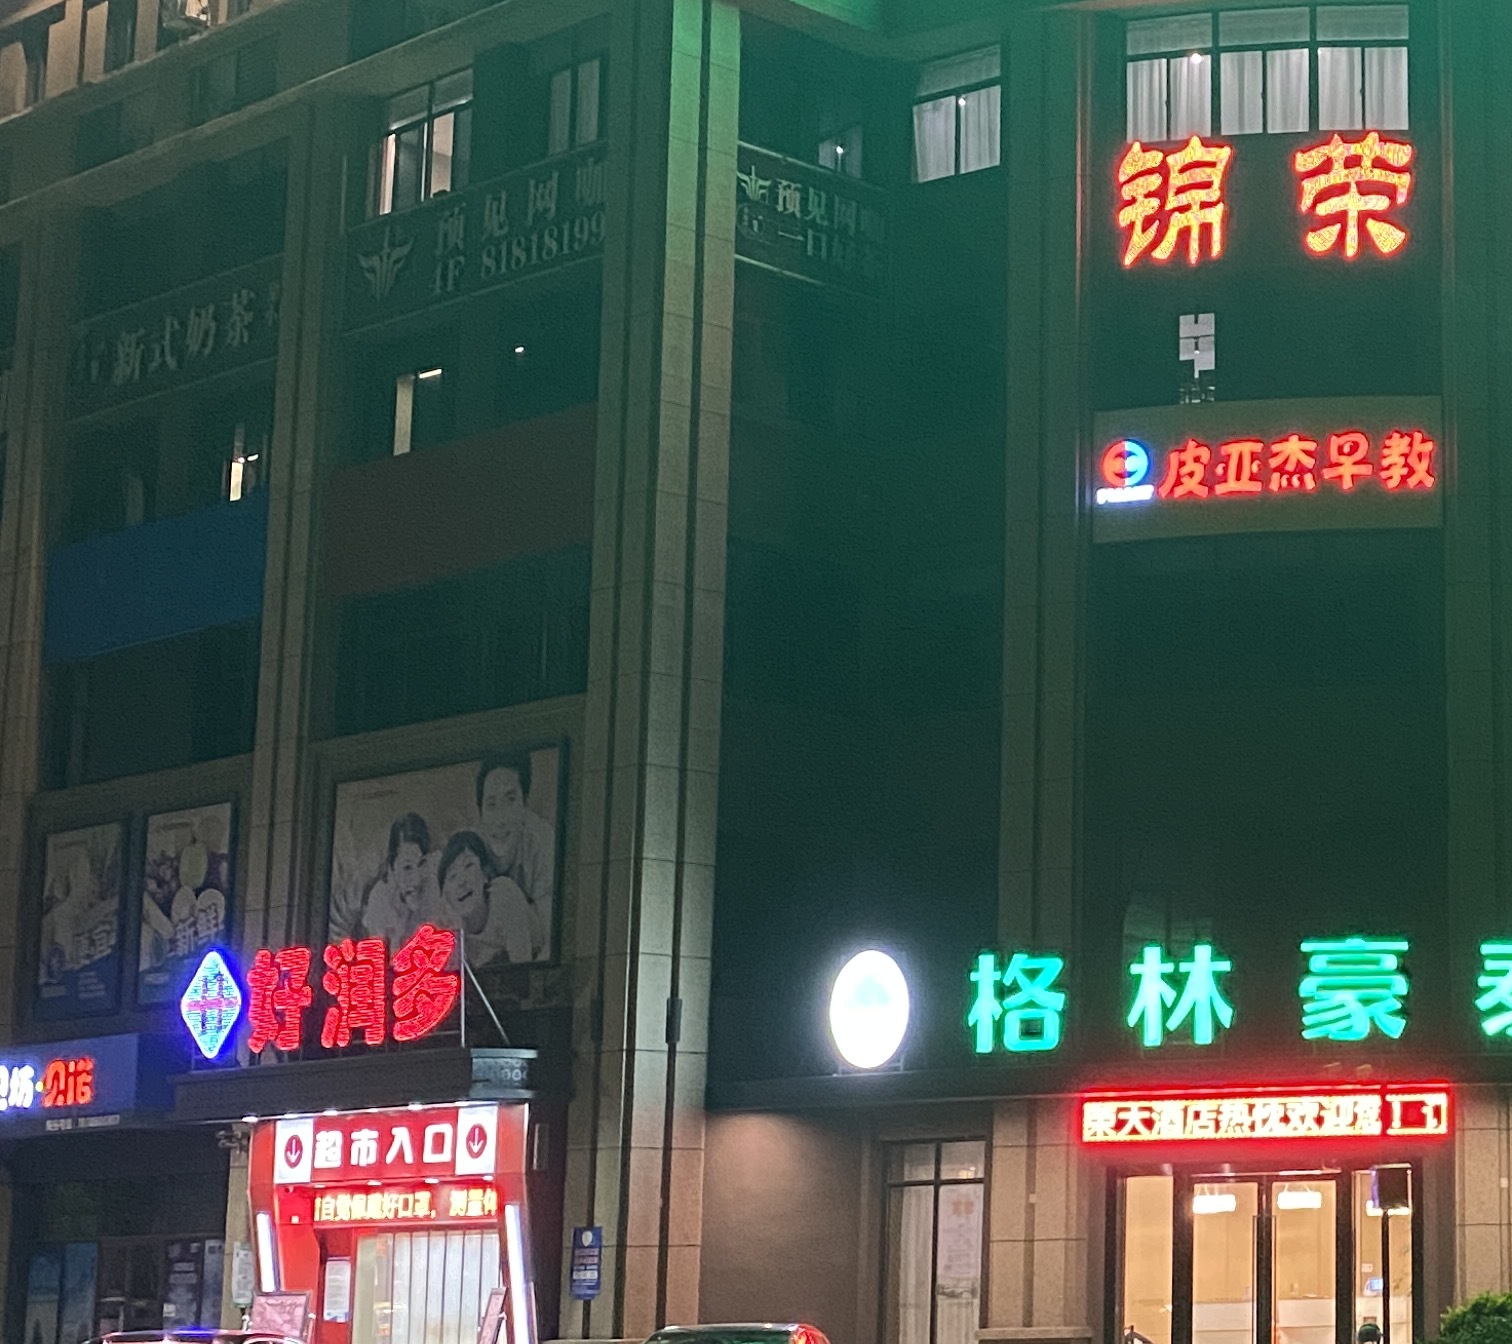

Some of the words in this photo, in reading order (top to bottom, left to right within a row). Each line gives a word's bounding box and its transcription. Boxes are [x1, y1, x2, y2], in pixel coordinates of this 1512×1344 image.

[1158, 430, 1435, 499] 皮亚杰早教
[247, 923, 461, 1054] 好润多
[314, 1123, 454, 1169] 超市入口
